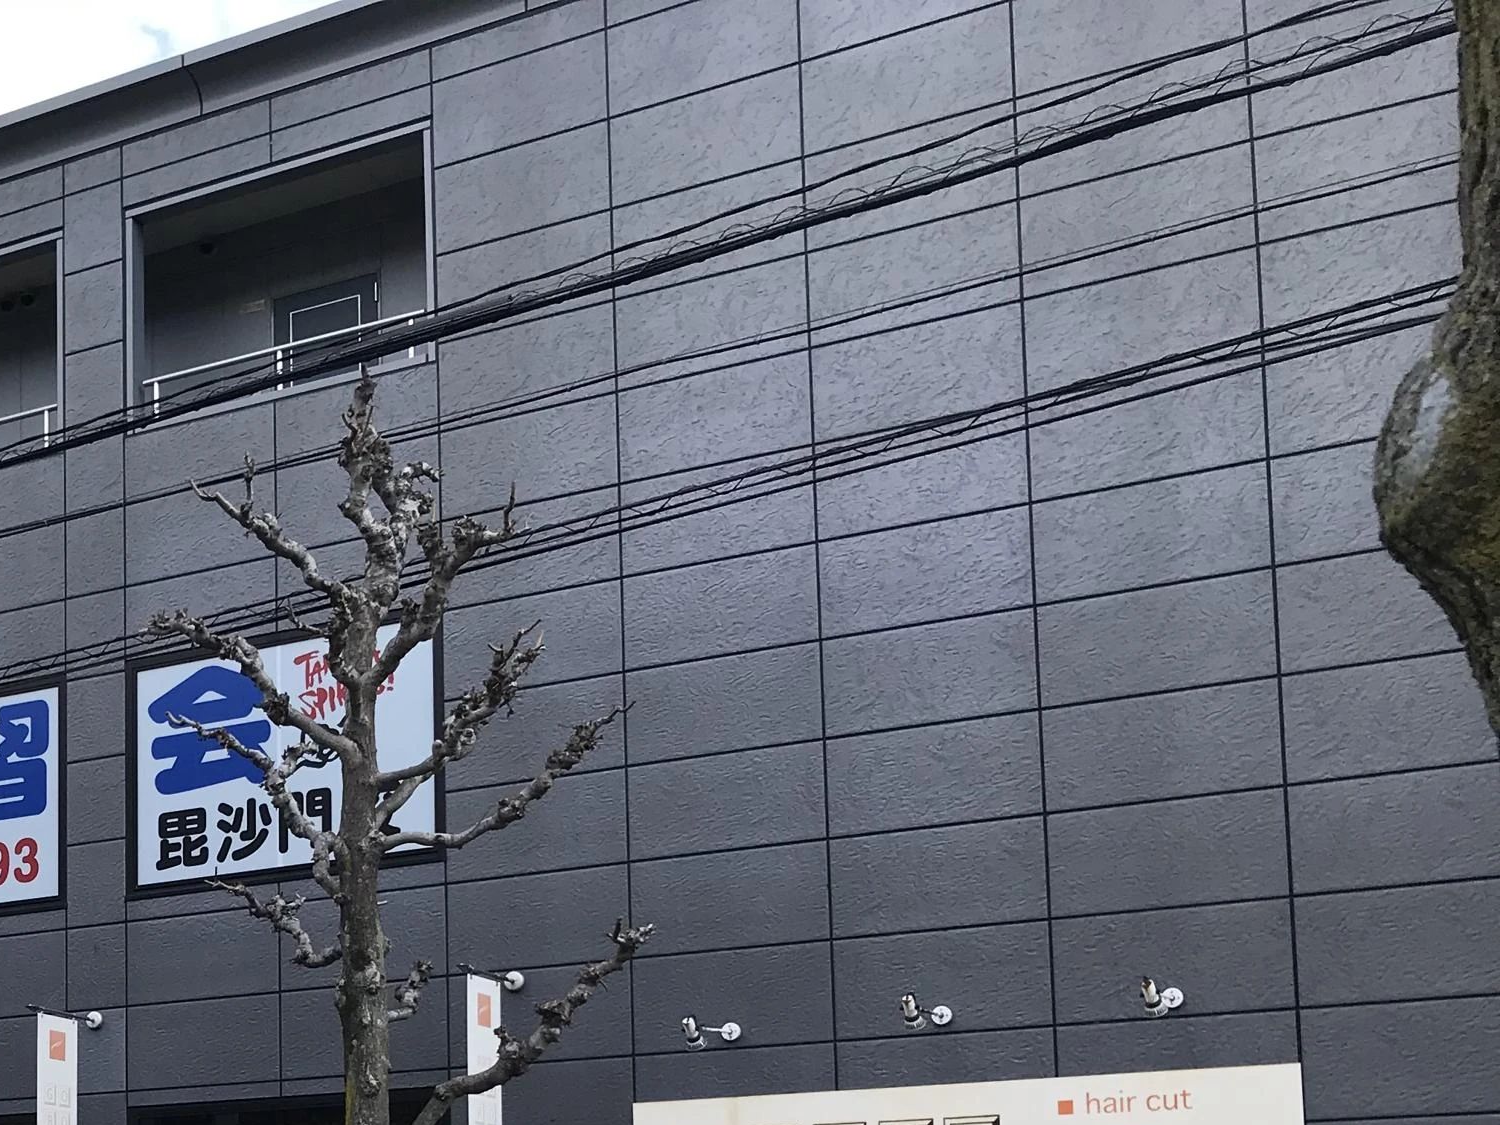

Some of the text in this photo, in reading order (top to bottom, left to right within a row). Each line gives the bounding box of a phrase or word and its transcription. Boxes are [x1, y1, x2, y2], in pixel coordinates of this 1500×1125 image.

[147, 665, 273, 795] 会
[155, 786, 401, 871] 毘沙門
[1085, 1089, 1193, 1114] hair cut
